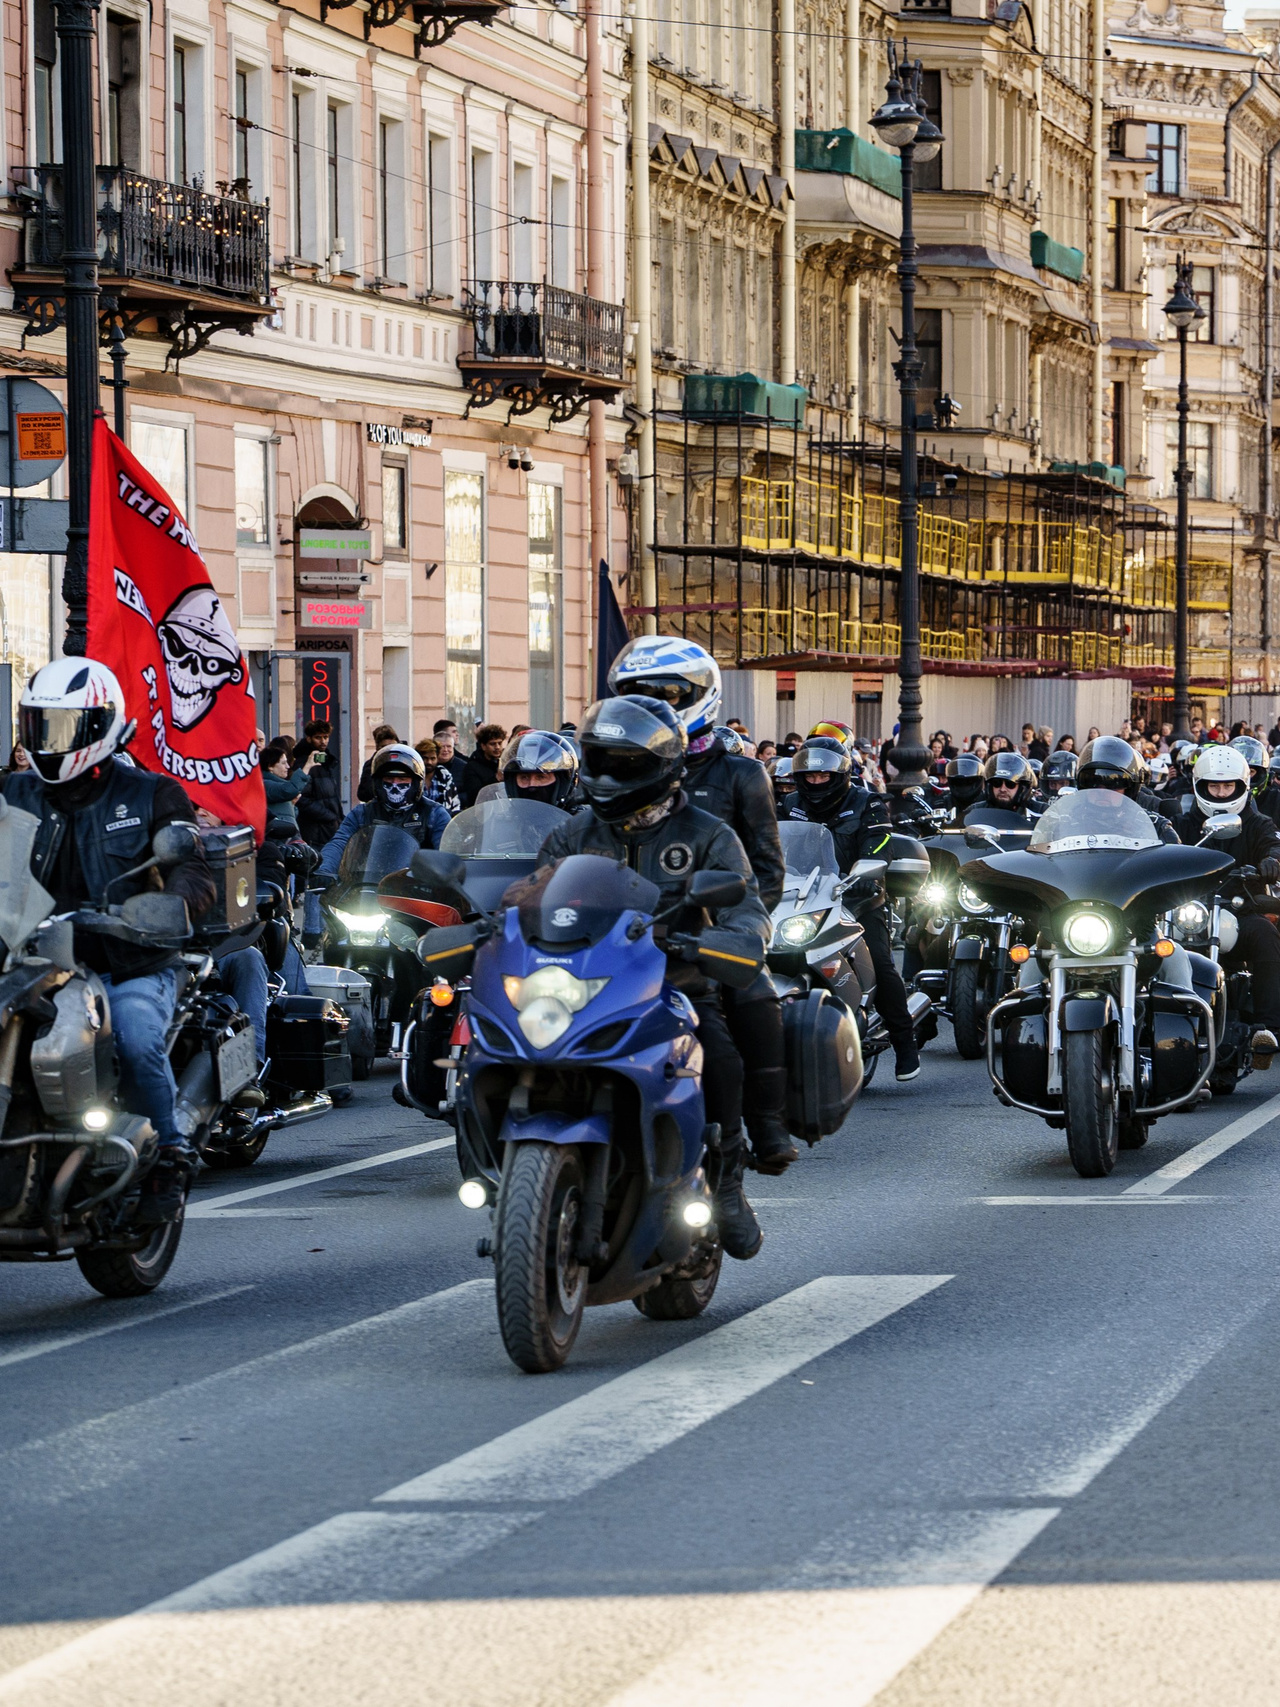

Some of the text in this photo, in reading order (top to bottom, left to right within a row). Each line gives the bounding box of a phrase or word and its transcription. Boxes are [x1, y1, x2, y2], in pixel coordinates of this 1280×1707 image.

[387, 426, 402, 445] YOU
[119, 472, 170, 527] THE
[300, 539, 338, 549] LINGERIE
[348, 540, 369, 550] TOYS
[307, 603, 366, 615] РОЗОВЫЙ
[311, 615, 360, 626] КРОЛИК
[594, 725, 621, 736] SHOEI
[108, 819, 138, 829] MEMBER
